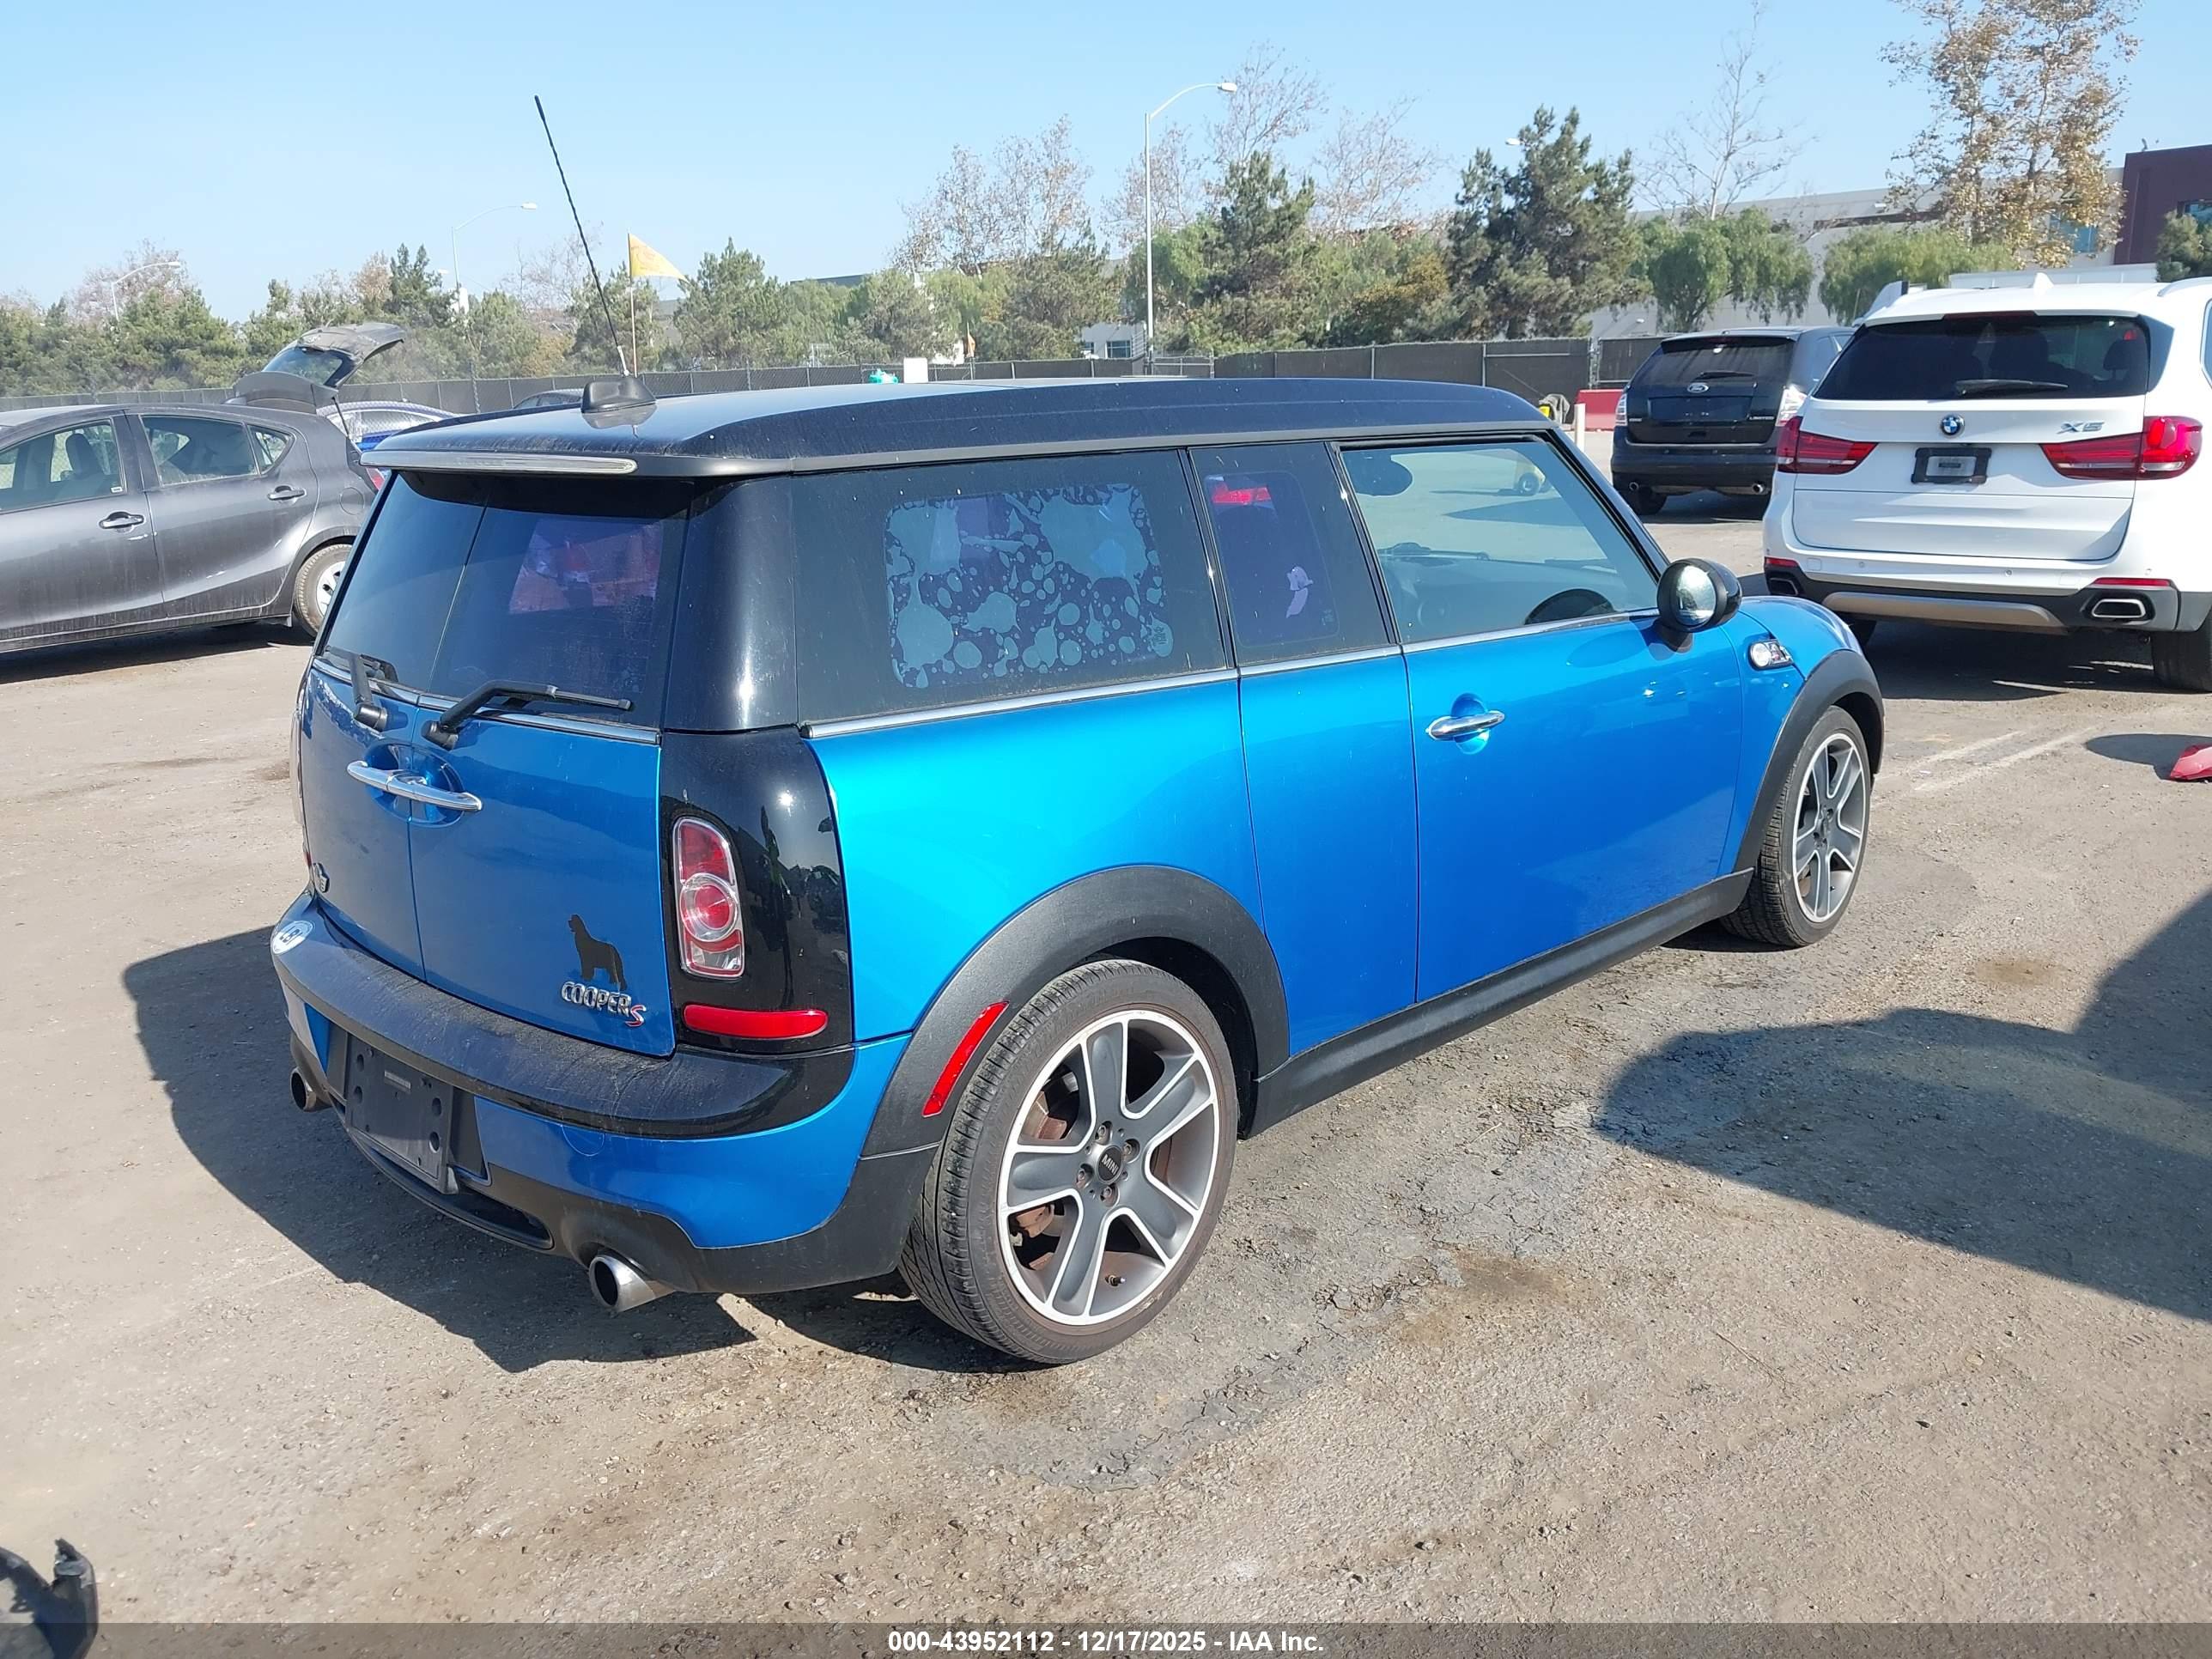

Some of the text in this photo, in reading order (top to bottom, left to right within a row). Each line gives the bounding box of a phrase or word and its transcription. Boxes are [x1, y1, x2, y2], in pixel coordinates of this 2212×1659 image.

[2057, 421, 2105, 434] X5
[562, 981, 647, 1027] COOPER S
[1102, 1154, 1119, 1175] MINI
